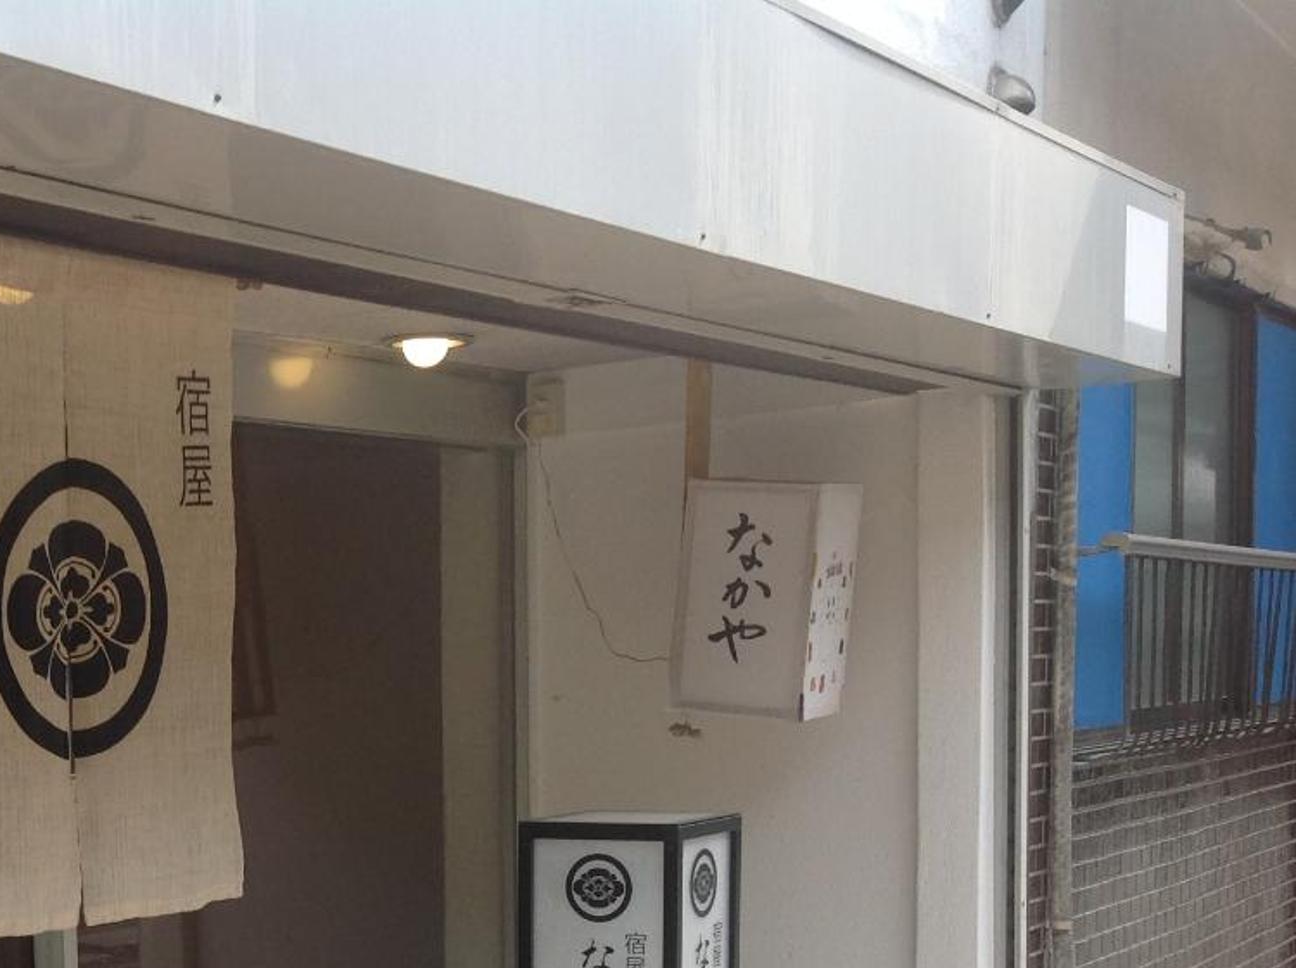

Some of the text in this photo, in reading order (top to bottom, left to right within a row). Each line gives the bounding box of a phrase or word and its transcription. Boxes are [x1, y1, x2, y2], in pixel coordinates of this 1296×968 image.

[174, 369, 214, 507] 宿屋
[707, 512, 773, 664] なかや
